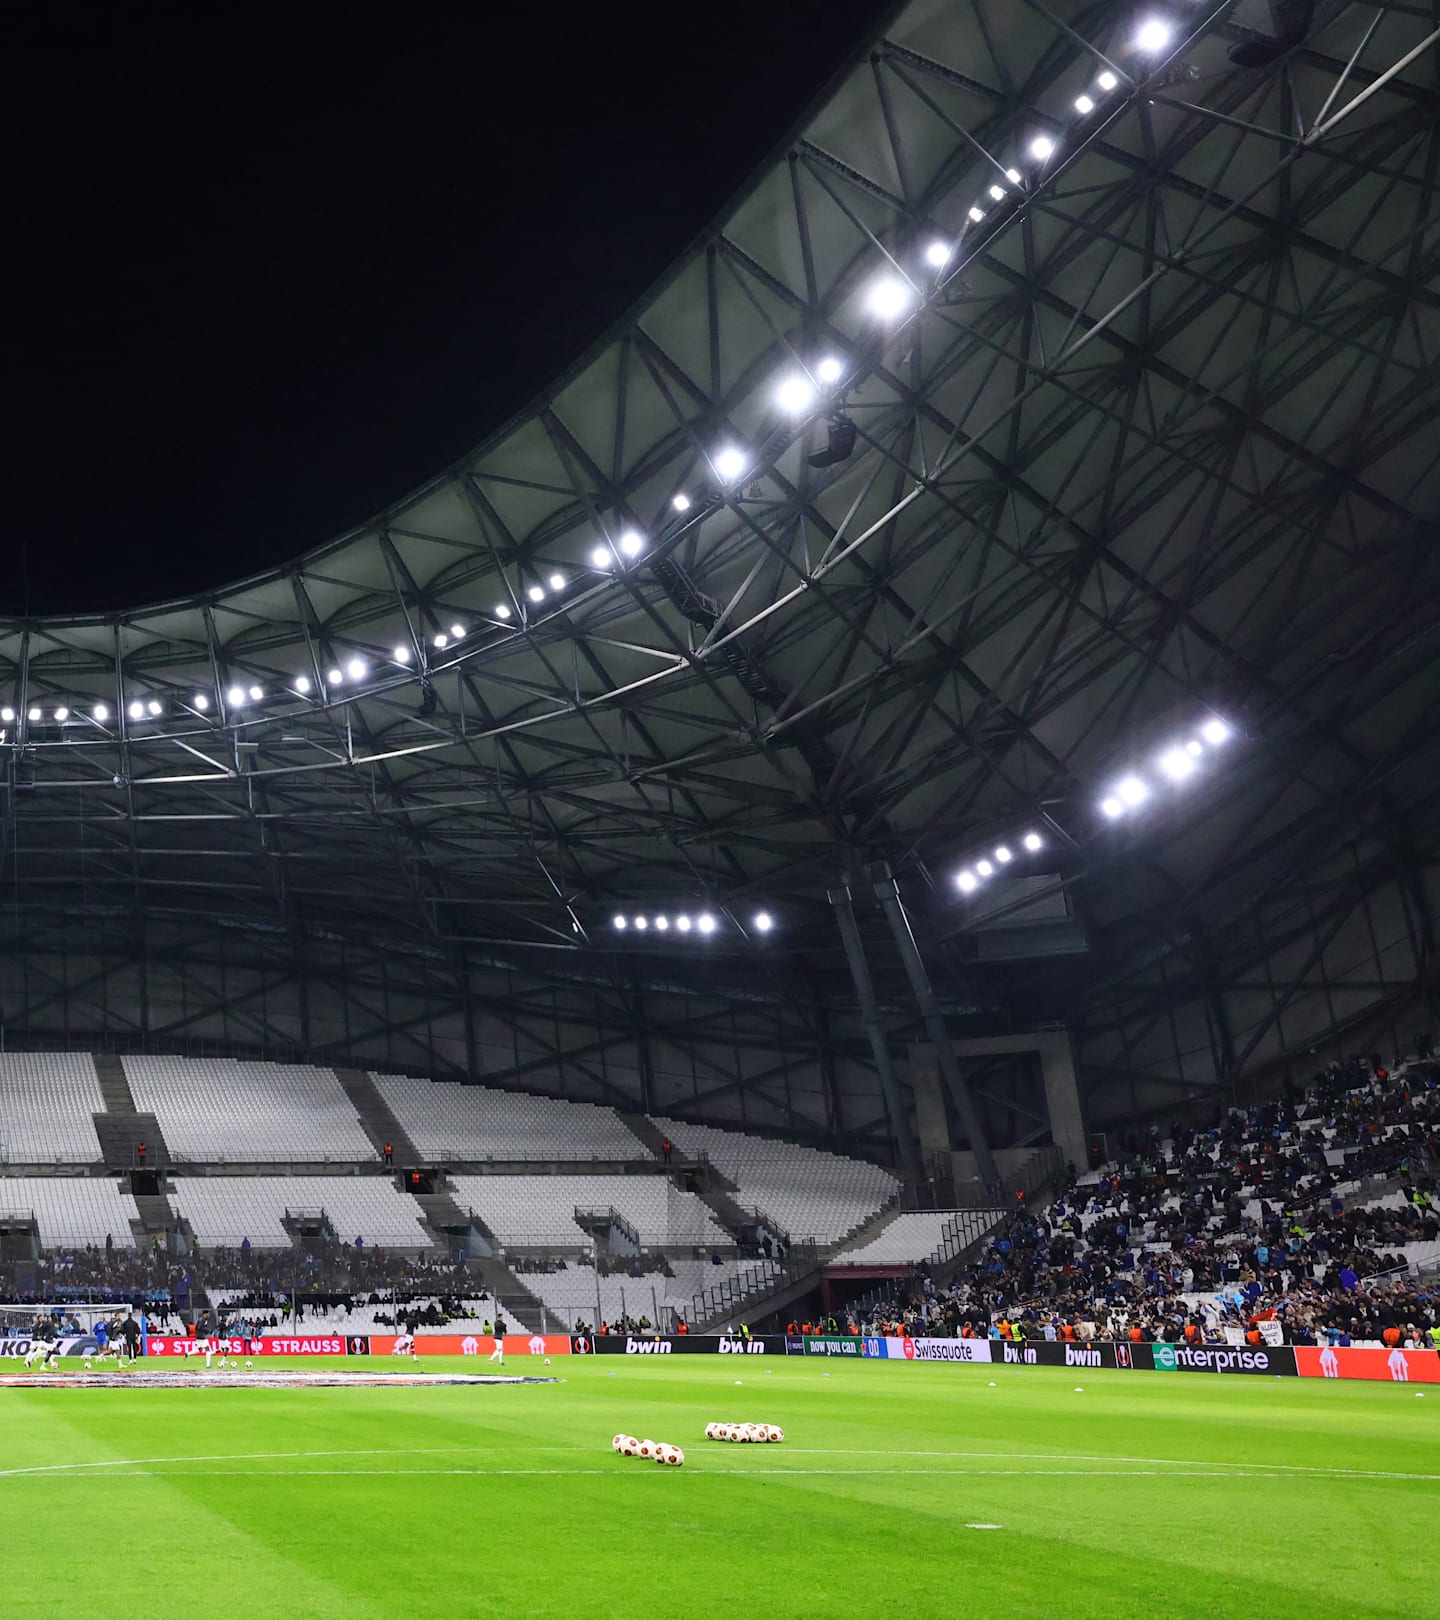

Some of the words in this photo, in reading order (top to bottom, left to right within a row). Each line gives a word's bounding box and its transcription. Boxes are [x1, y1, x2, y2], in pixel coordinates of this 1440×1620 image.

[271, 1339, 341, 1353] STRAUSS
[625, 1336, 672, 1354] bwin
[718, 1336, 765, 1354] bwin
[809, 1341, 825, 1353] now
[826, 1341, 841, 1356] you
[841, 1341, 857, 1353] can
[914, 1339, 973, 1361] Swissquote
[1065, 1343, 1101, 1366] bwin
[1153, 1346, 1269, 1373] enterprise
